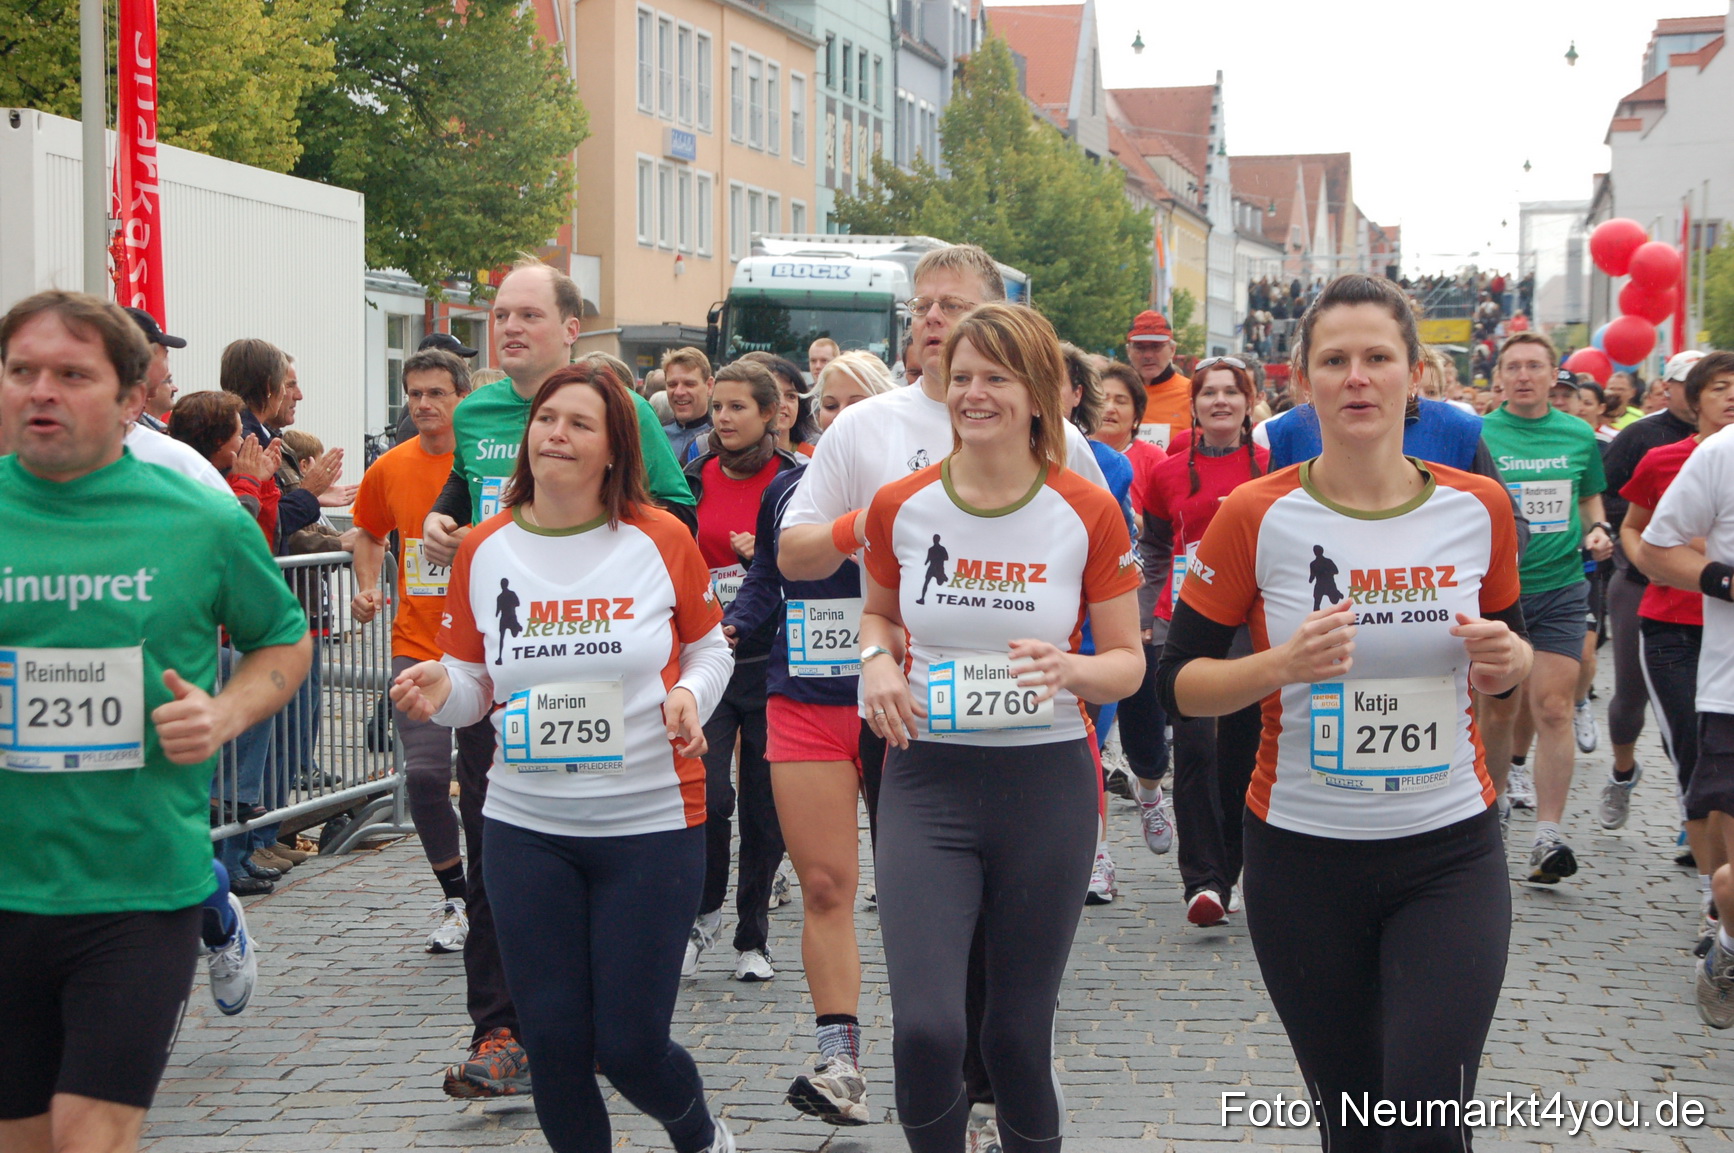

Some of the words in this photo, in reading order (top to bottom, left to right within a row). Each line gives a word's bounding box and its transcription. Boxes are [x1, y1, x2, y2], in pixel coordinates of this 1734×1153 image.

[771, 262, 851, 280] BOCK
[1498, 454, 1569, 474] Sinupret
[1525, 487, 1557, 496] Andreas
[1525, 500, 1564, 515] 3317
[427, 561, 452, 577] 27
[717, 570, 738, 580] DEHN
[956, 558, 1047, 583] MERZ
[1350, 565, 1458, 592] MERZ
[0, 566, 153, 611] inupret
[720, 582, 740, 594] Man
[947, 571, 1026, 593] Reisen
[936, 593, 986, 607] TEAM
[992, 598, 1035, 612] 2008
[1347, 583, 1438, 605] Reisen
[530, 597, 635, 624] MERZ
[809, 607, 844, 621] Carina
[1350, 611, 1393, 626] EAM
[1401, 609, 1449, 624] 2008
[522, 615, 611, 638] Reisen
[512, 645, 567, 660] TEAM
[574, 641, 622, 656] 2008
[25, 661, 105, 682] Reinhold
[537, 693, 586, 710] Marion
[966, 690, 1039, 716] 2760
[1354, 691, 1398, 716] Katja
[28, 696, 122, 728] 2310
[511, 721, 518, 734] D
[540, 718, 611, 745] 2759
[1322, 724, 1330, 739] D
[1356, 721, 1437, 754] 2761
[579, 761, 624, 771] PFLEIDERER
[1401, 771, 1449, 786] PFLEIDERER
